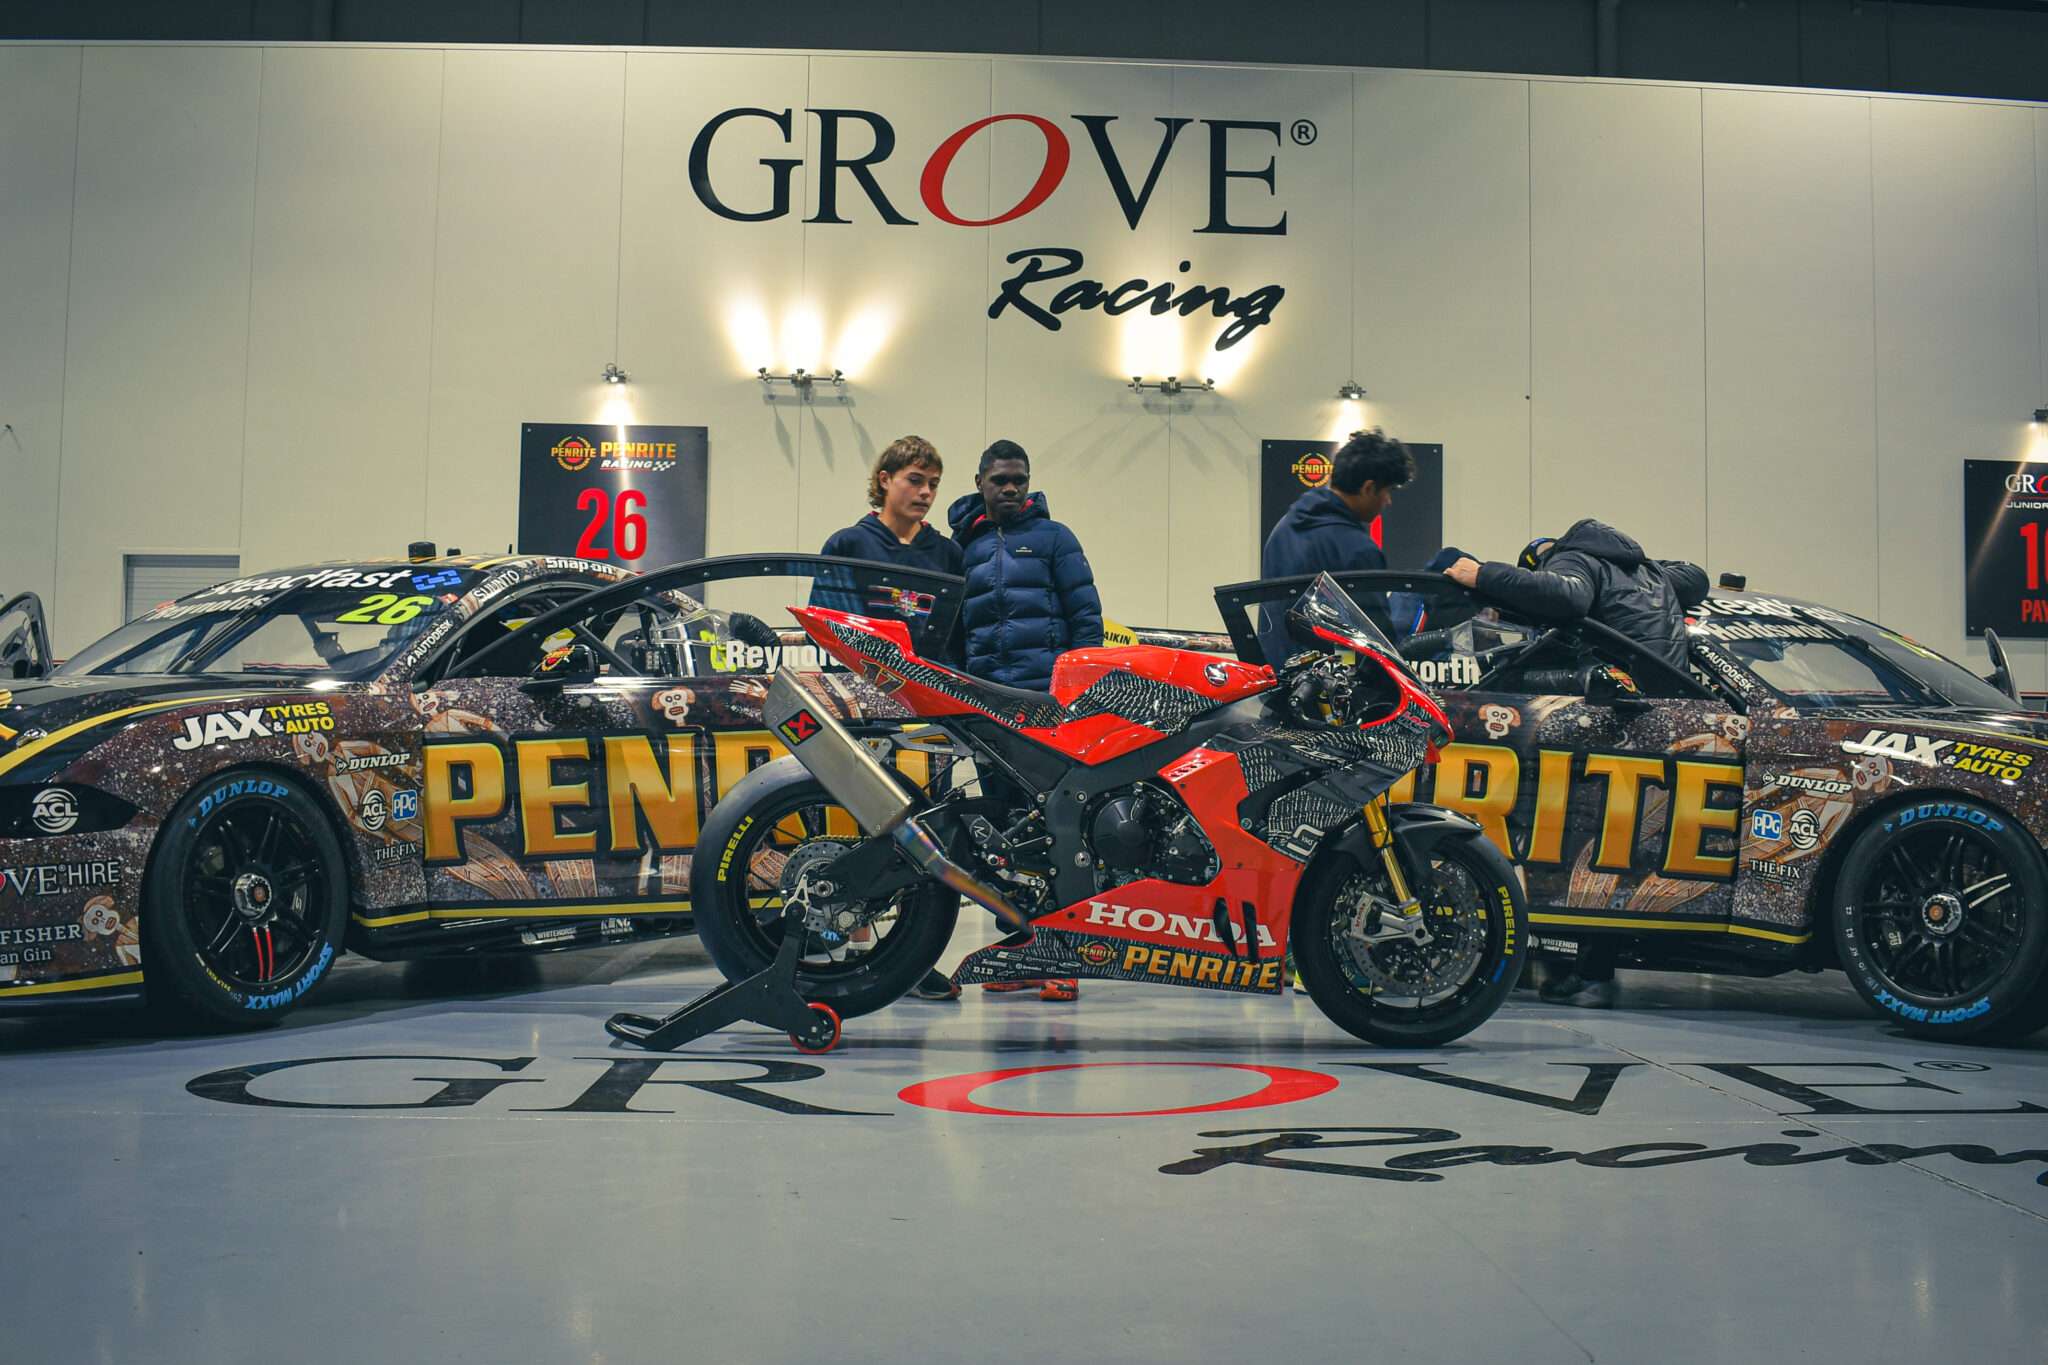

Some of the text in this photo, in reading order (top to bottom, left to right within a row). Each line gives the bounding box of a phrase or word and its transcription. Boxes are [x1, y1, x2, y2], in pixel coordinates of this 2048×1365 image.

[987, 247, 1286, 351] Racing
[551, 446, 597, 458] PENRITE
[601, 441, 677, 458] PENRITE
[1291, 463, 1334, 475] PENRIT
[576, 487, 648, 560] 26
[2020, 522, 2048, 591] 1
[336, 593, 434, 625] 26
[413, 619, 453, 660] AUTODESK
[1103, 631, 1131, 646] AIKIN
[726, 640, 848, 675] Reynol
[1706, 651, 1756, 694] AUTODESK
[266, 702, 330, 720] TYRES
[173, 708, 273, 751] JAX
[273, 716, 335, 734] & AUTO
[1840, 729, 1955, 767] JAX
[1953, 742, 2033, 768] TYRES
[350, 753, 411, 771] DUNLOP
[1943, 755, 2023, 781] & AUTO
[200, 779, 289, 817] DUNLOP
[1775, 775, 1853, 795] DUNLOP
[33, 802, 79, 818] ACL
[361, 803, 386, 818] ACL
[1900, 803, 2005, 833] DUNLOP
[1788, 823, 1819, 837] ACL
[375, 846, 396, 860] THE
[717, 815, 754, 882] PIRELLI
[68, 861, 120, 886] HIRE
[1750, 859, 1800, 879] THE FIX
[1497, 886, 1516, 956] PIRELLI
[23, 947, 51, 962] Gin
[1077, 946, 1119, 960] PENRITE
[244, 941, 334, 1009] SPORT MAXX
[1123, 945, 1281, 990] PENRITE
[1873, 989, 1929, 1022] MAXX
